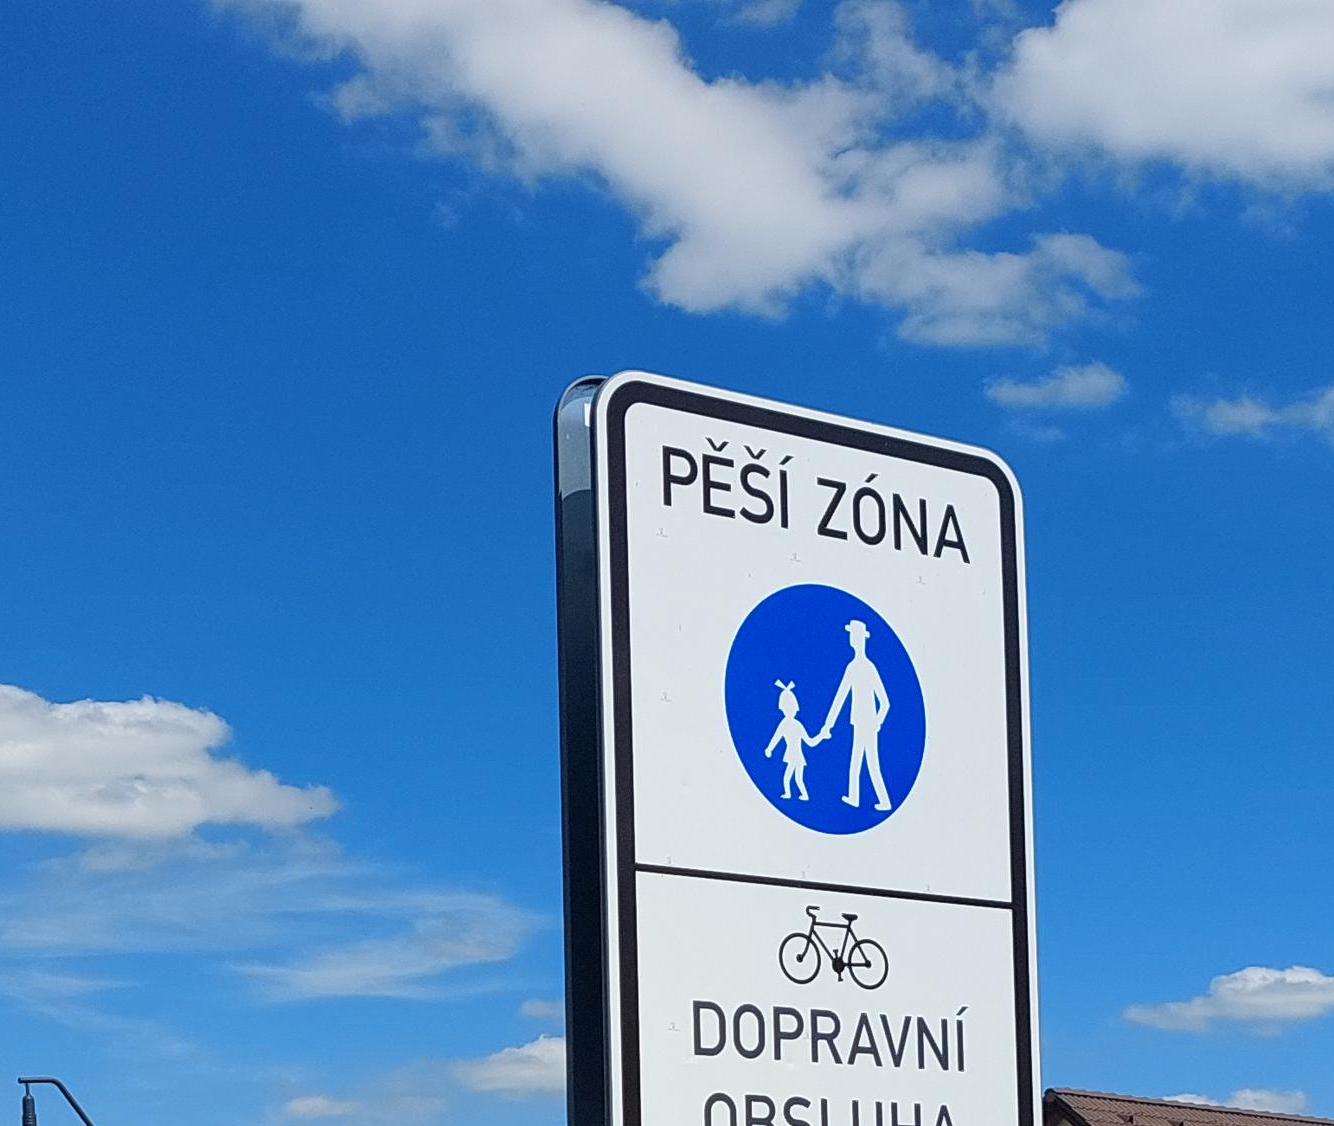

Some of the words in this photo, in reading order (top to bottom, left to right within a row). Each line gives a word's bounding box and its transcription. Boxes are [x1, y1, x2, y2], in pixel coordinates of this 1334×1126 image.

[662, 437, 795, 530] PĚŠÍ
[816, 472, 971, 565] ZÓNA
[692, 999, 969, 1073] DOPRAVNÍ
